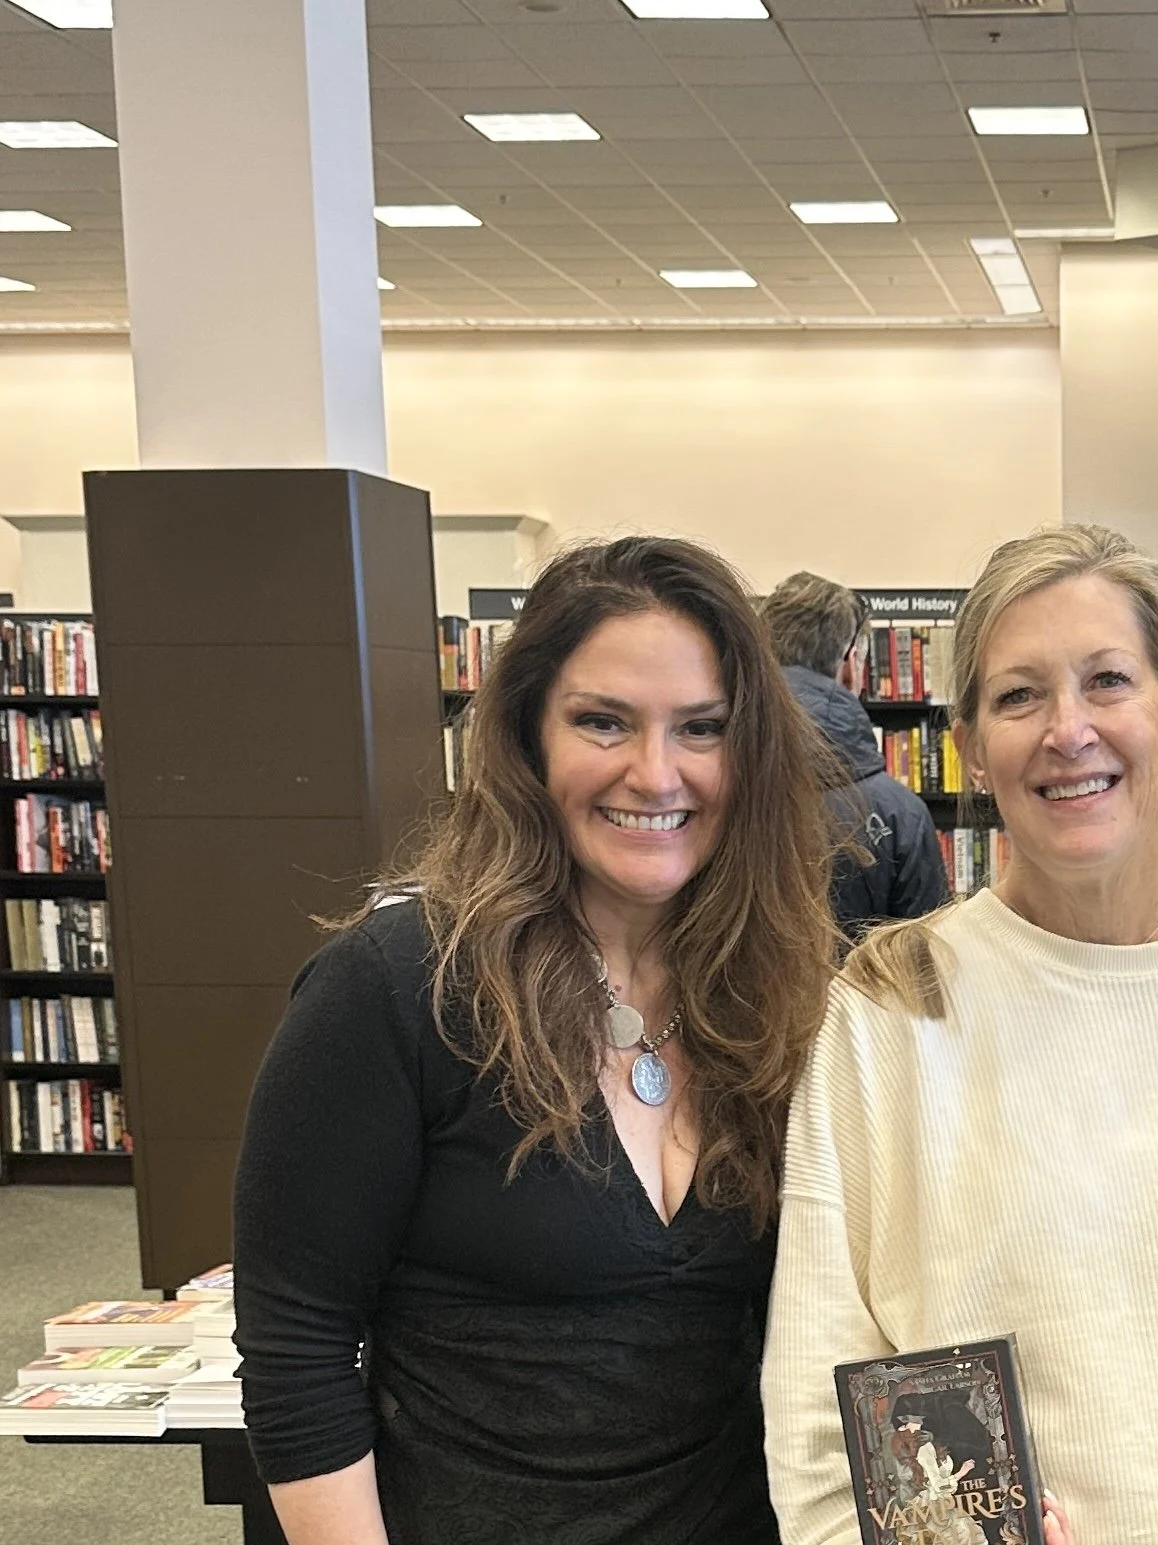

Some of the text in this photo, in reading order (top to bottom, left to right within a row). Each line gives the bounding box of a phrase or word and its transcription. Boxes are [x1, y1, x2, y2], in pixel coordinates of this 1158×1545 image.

[870, 597, 958, 614] World History
[960, 1478, 987, 1491] THE
[867, 1484, 1027, 1530] VAMPIRE'S
